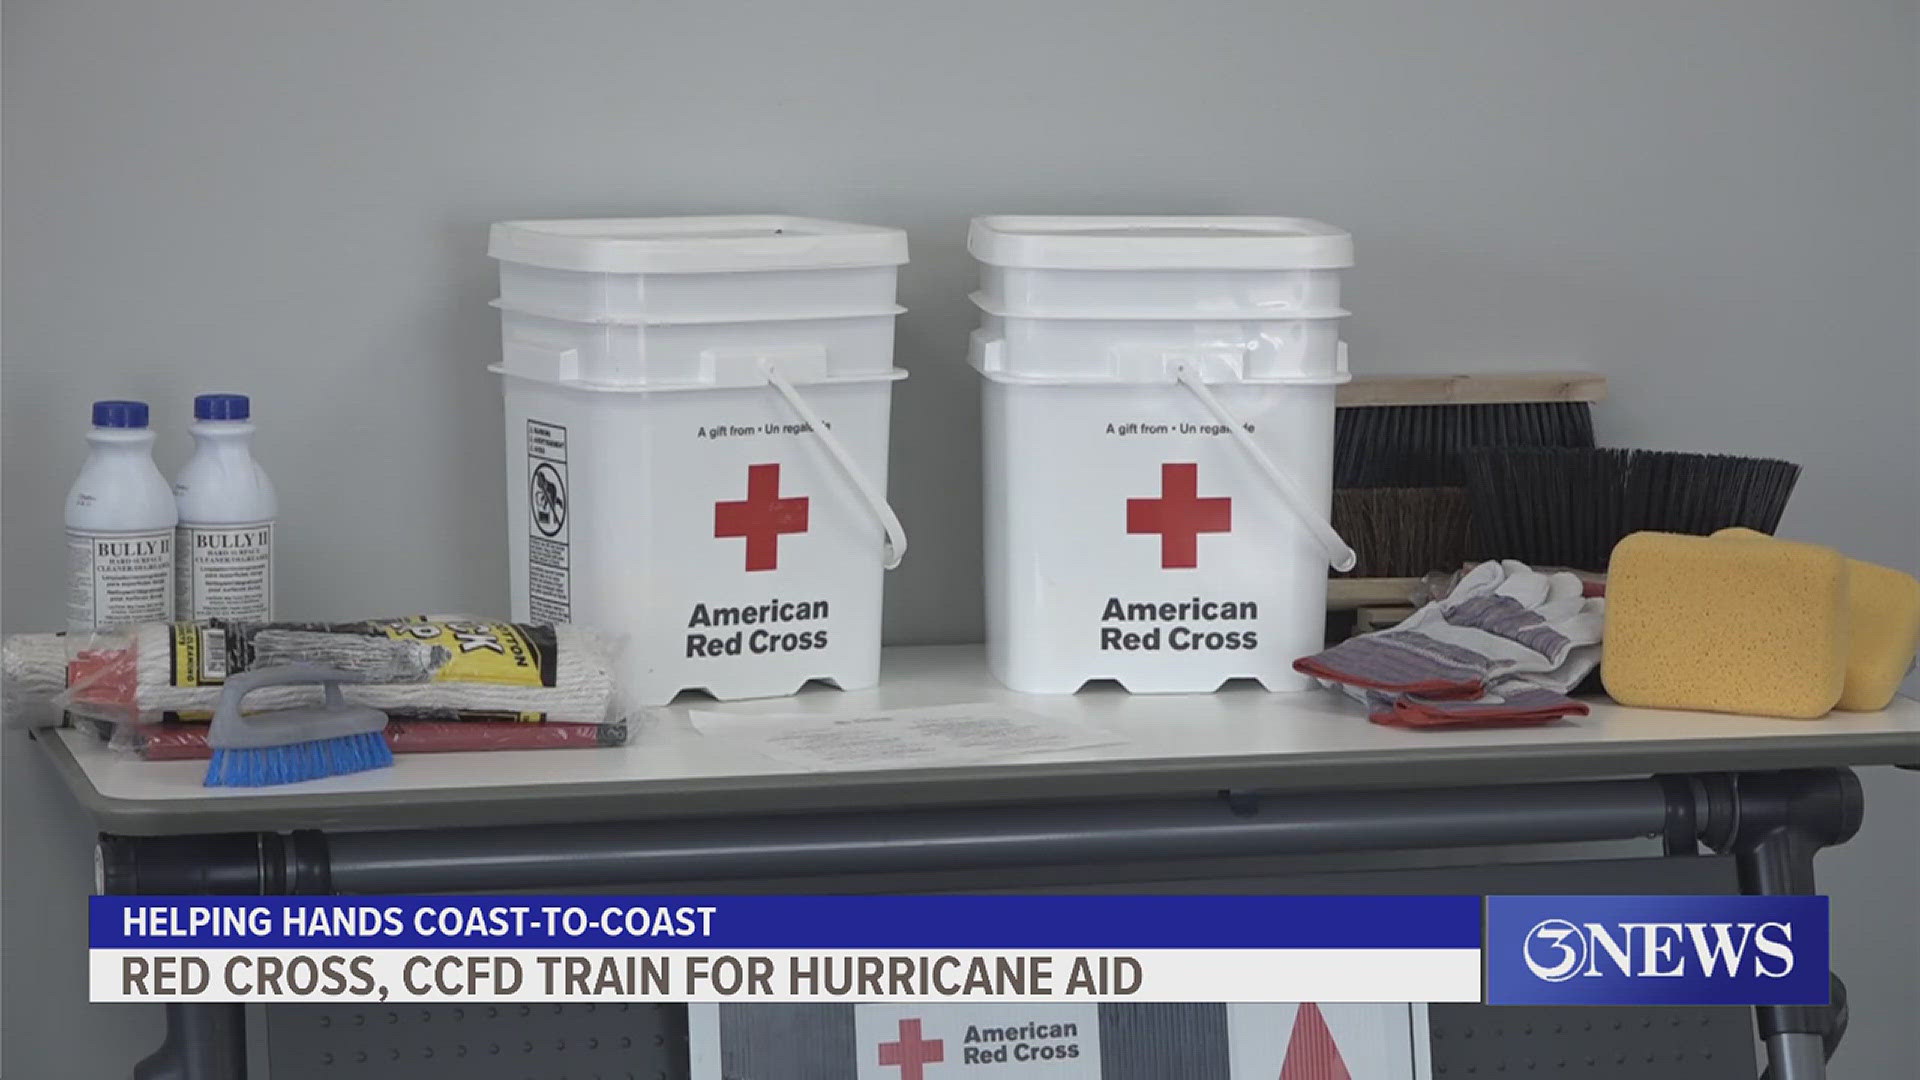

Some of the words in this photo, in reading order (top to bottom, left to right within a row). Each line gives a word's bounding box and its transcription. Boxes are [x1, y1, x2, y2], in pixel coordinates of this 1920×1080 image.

[698, 427, 706, 438] A
[709, 426, 727, 439] gift
[730, 425, 755, 436] from
[765, 424, 780, 434] Un
[783, 422, 815, 435] regal
[1106, 423, 1115, 434] A
[1118, 423, 1137, 436] gift
[1141, 423, 1168, 434] from
[1180, 423, 1196, 434] Un
[98, 541, 157, 557] BULLY
[161, 540, 169, 553] II
[197, 532, 254, 548] BULLY
[259, 531, 267, 545] II
[688, 599, 829, 628] American
[1101, 598, 1258, 621] American
[686, 632, 743, 658] Red
[749, 629, 828, 654] Cross
[1101, 627, 1160, 651] Red
[1168, 626, 1258, 651] Cross
[964, 1021, 1078, 1043] American
[964, 1045, 1008, 1064] Red
[1014, 1043, 1080, 1061] Cross
